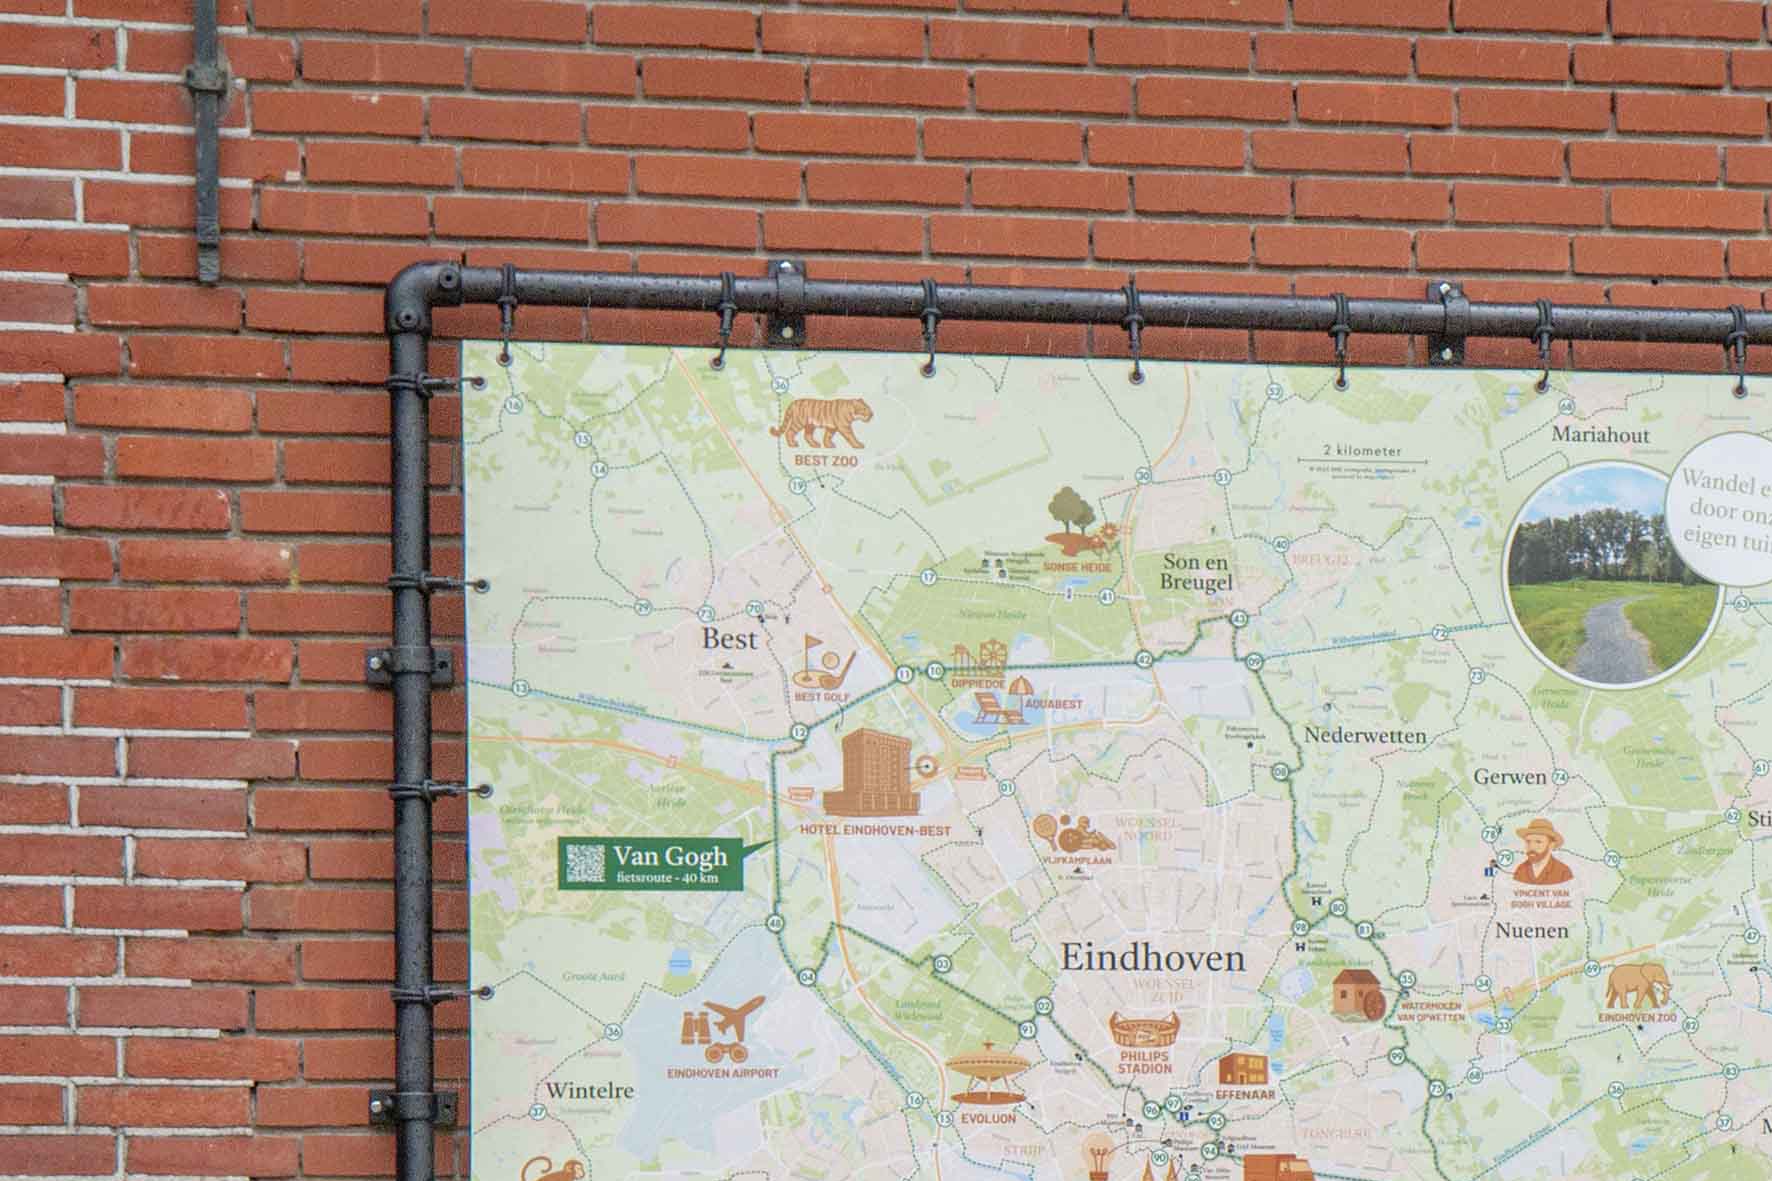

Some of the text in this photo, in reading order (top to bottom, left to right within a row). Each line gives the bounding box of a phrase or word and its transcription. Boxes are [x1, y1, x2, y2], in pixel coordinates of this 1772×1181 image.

[1551, 426, 1650, 444] Mariahout
[1324, 445, 1401, 457] 2 kilometer
[794, 455, 858, 468] BEST ZOO
[1683, 467, 1755, 497] Wandel
[1690, 499, 1736, 520] door
[1683, 525, 1737, 549] eigen
[1163, 553, 1228, 572] Son en
[1160, 572, 1233, 596] Breugel
[702, 627, 759, 650] Best
[951, 679, 1005, 689] DIPPIEDOE
[795, 692, 849, 702] BEST GOLF
[1025, 699, 1082, 710] AQUABEST
[1304, 726, 1427, 744] Nederwetten
[1473, 768, 1547, 785] Gerwen
[800, 825, 951, 837] HOTEL EINDHOVEN-BEST
[612, 846, 728, 871] Van Gogh
[617, 872, 672, 884] fietsroute
[683, 873, 698, 886] 40
[700, 872, 719, 884] km
[1513, 889, 1548, 898] VINCENT
[1495, 923, 1569, 939] Nuenen
[1061, 942, 1246, 973] Eindhoven
[1599, 1013, 1677, 1023] EINDHOVEN ZOO
[1121, 1051, 1169, 1062] PHILIPS
[667, 1069, 780, 1079] EINDHOVEN AIRPORT
[1118, 1064, 1173, 1074] STADION
[546, 1081, 634, 1099] Wintelre
[1216, 1090, 1276, 1100] EFFENAAR
[961, 1113, 1016, 1125] EVOLUON
